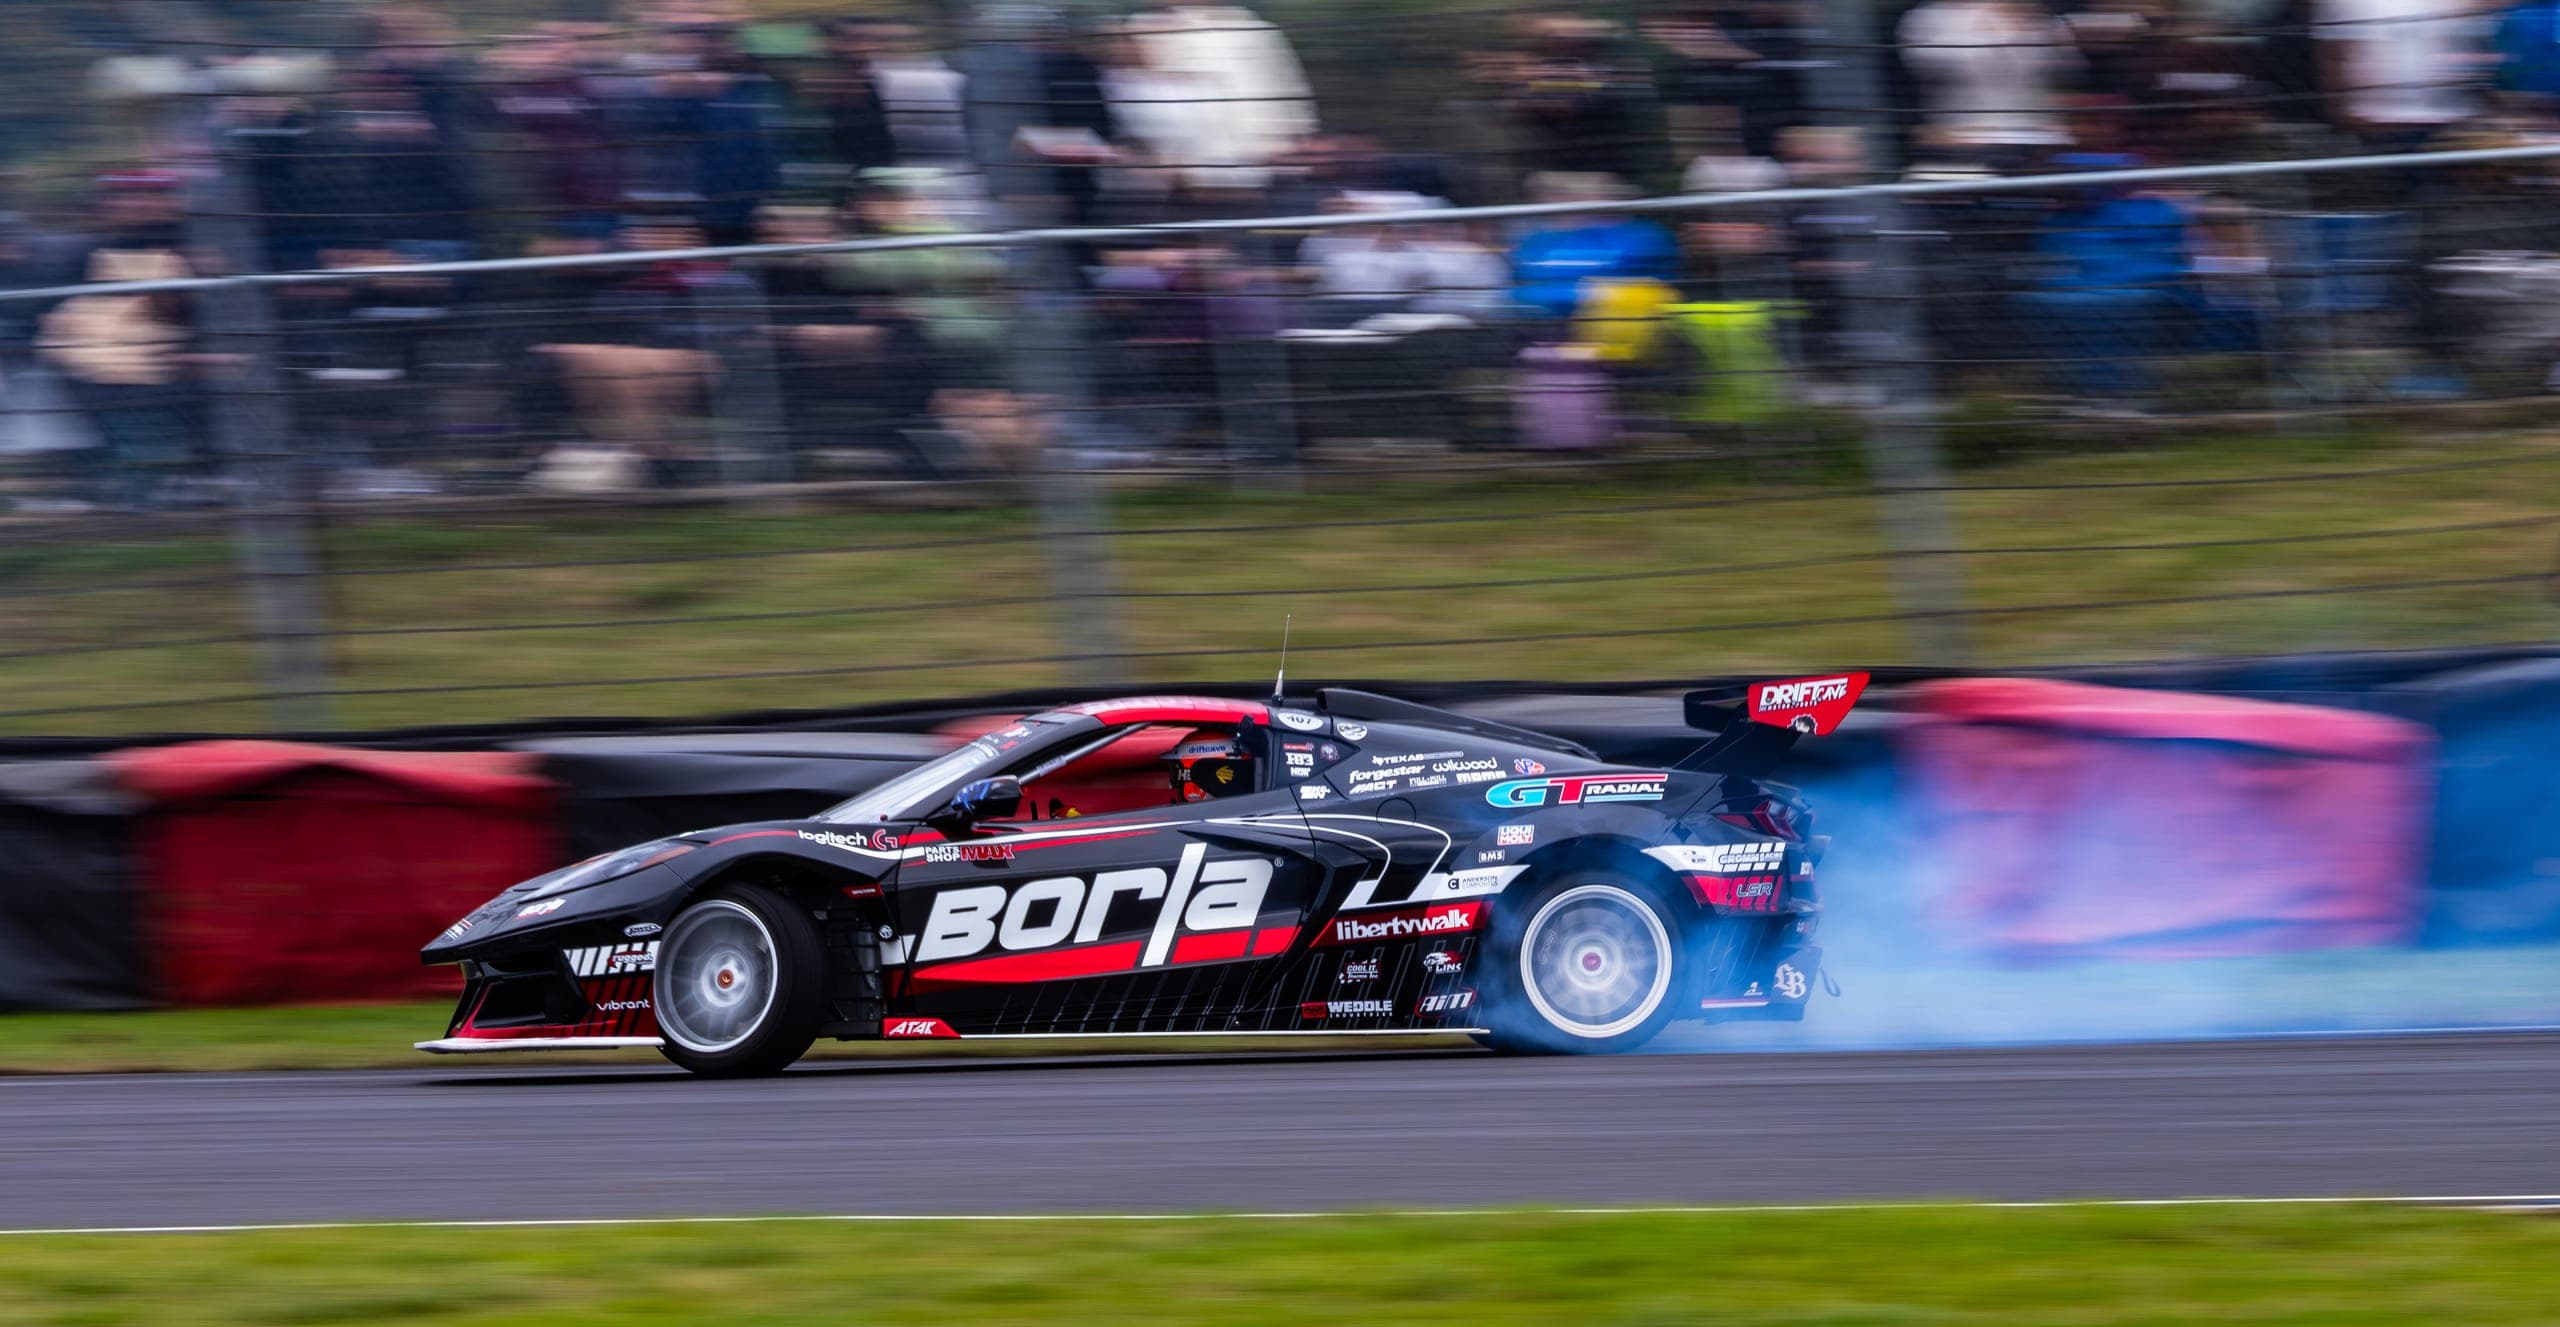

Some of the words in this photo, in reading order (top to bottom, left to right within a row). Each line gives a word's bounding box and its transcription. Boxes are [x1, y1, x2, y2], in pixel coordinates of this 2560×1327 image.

[1349, 764, 1426, 785] forgestar
[1486, 774, 1640, 808] GT
[1586, 783, 1665, 795] RADIAL
[1500, 825, 1532, 835] LIQUI
[798, 829, 868, 848] logitech
[1499, 834, 1532, 844] MOLY
[925, 846, 960, 855] PARTS
[926, 853, 960, 863] SHOP
[960, 843, 1015, 861] MAX
[1737, 882, 1773, 897] LSR
[1336, 909, 1469, 940] libertywalk
[596, 999, 651, 1011] vibrant
[1327, 1000, 1393, 1014] WEDDLE
[889, 1021, 937, 1036] ATAK
